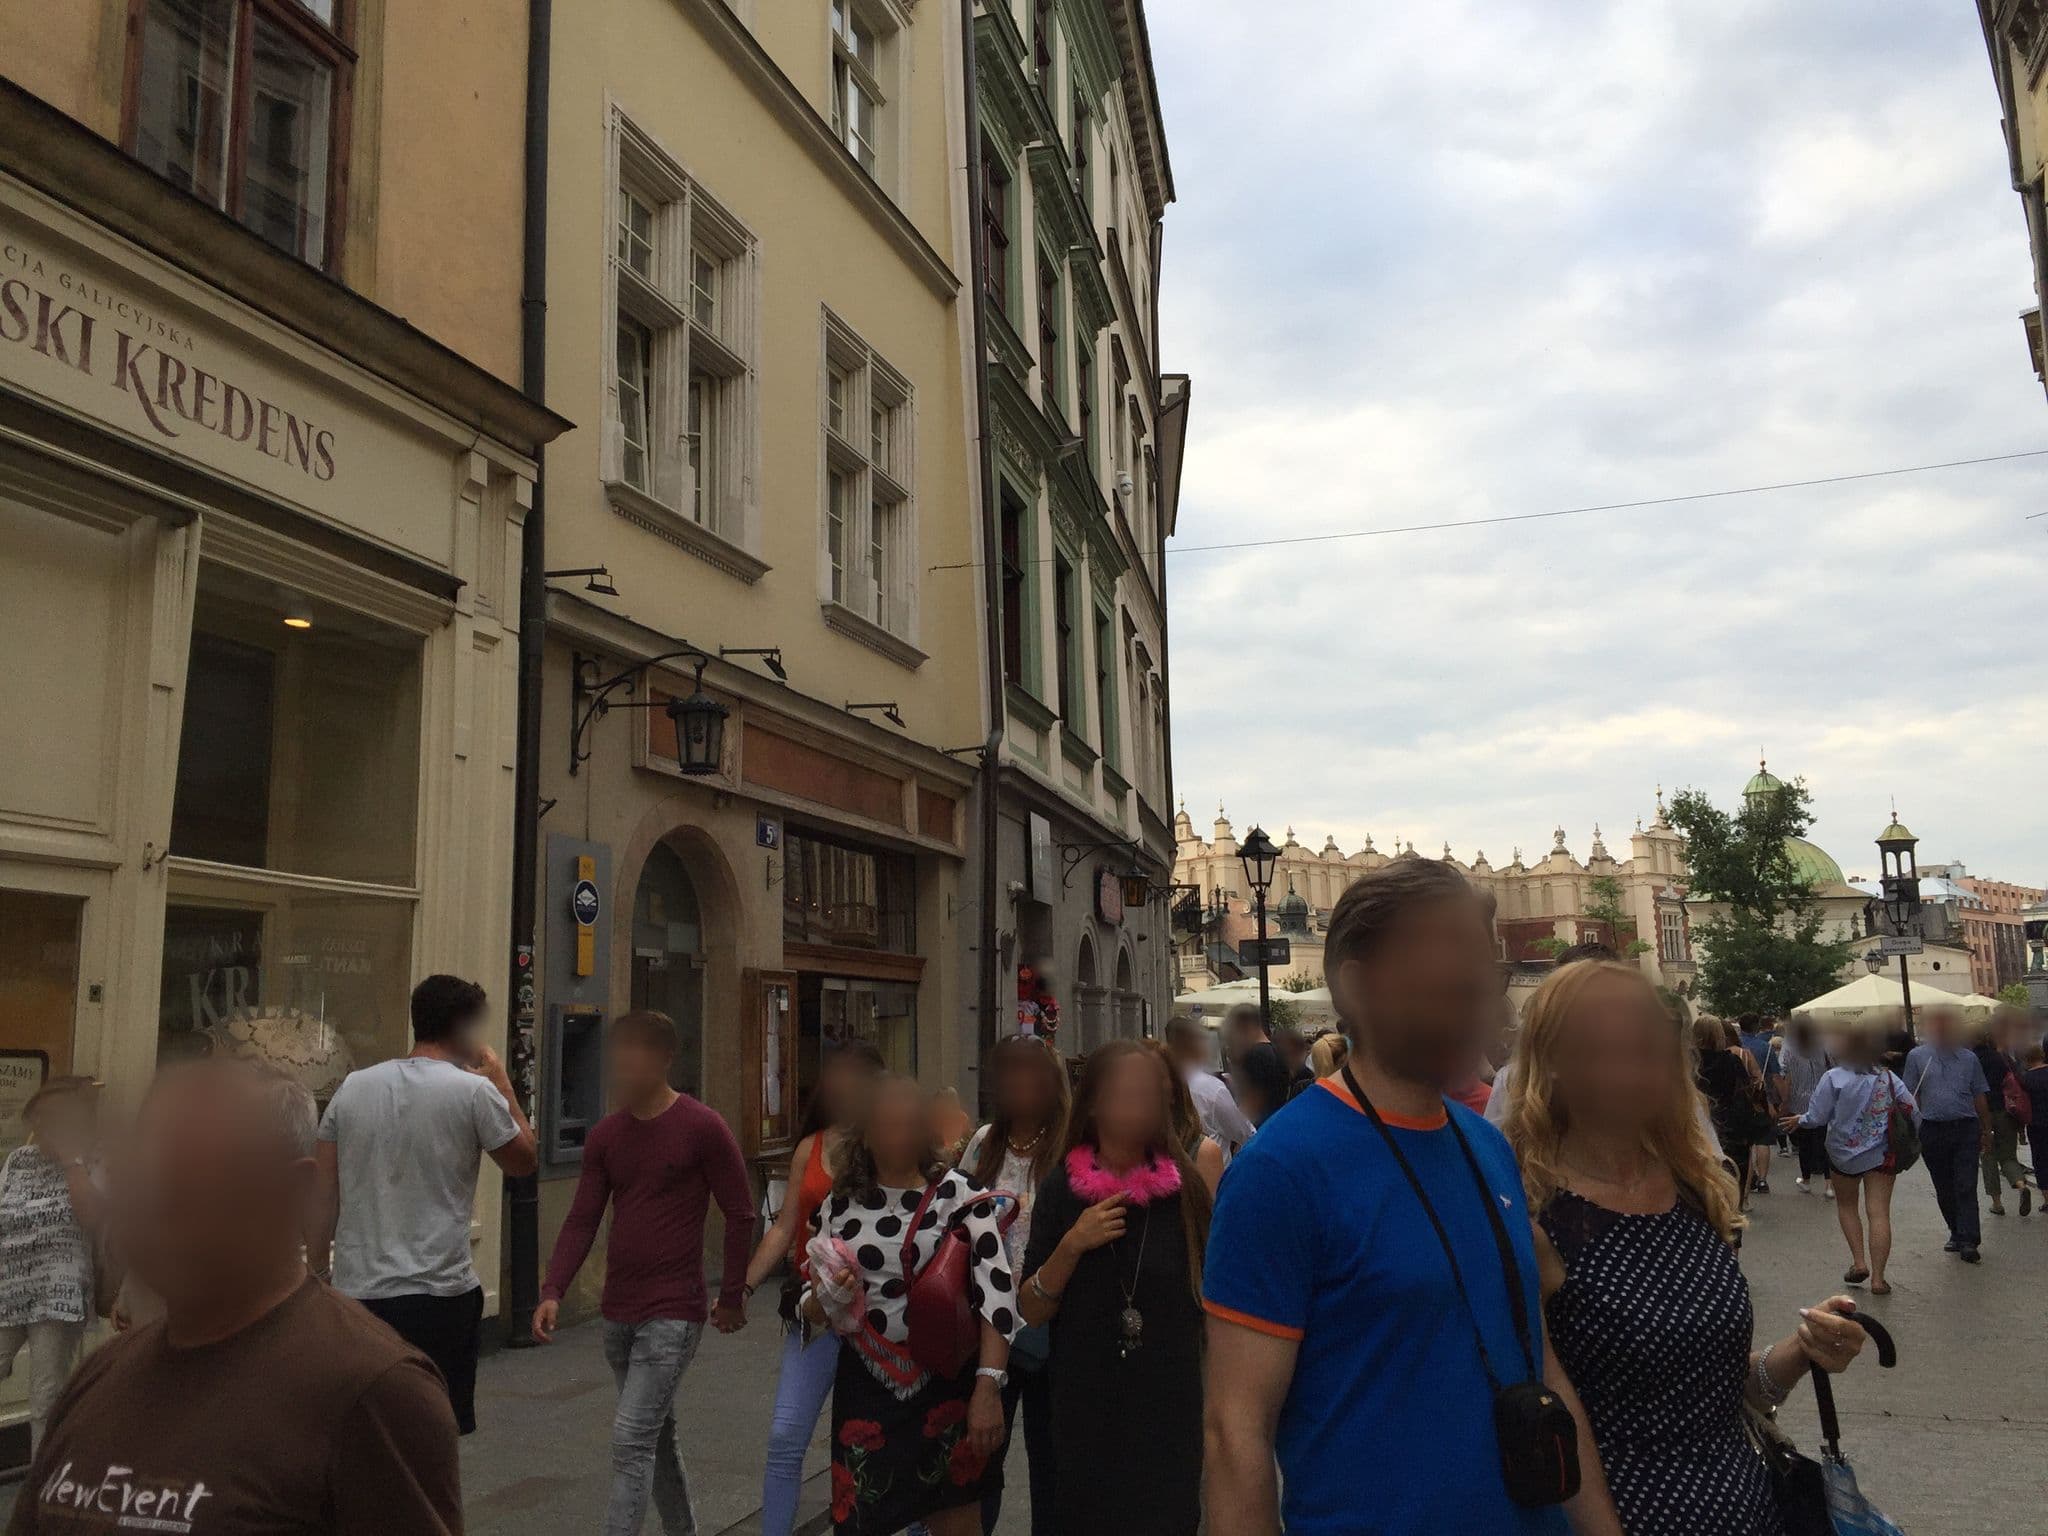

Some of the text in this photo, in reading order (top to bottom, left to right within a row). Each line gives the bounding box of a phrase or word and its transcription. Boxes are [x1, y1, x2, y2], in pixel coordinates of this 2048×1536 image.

[59, 273, 194, 351] GALICYJSKA
[0, 272, 335, 481] SKI KREDENS
[766, 825, 773, 844] 5
